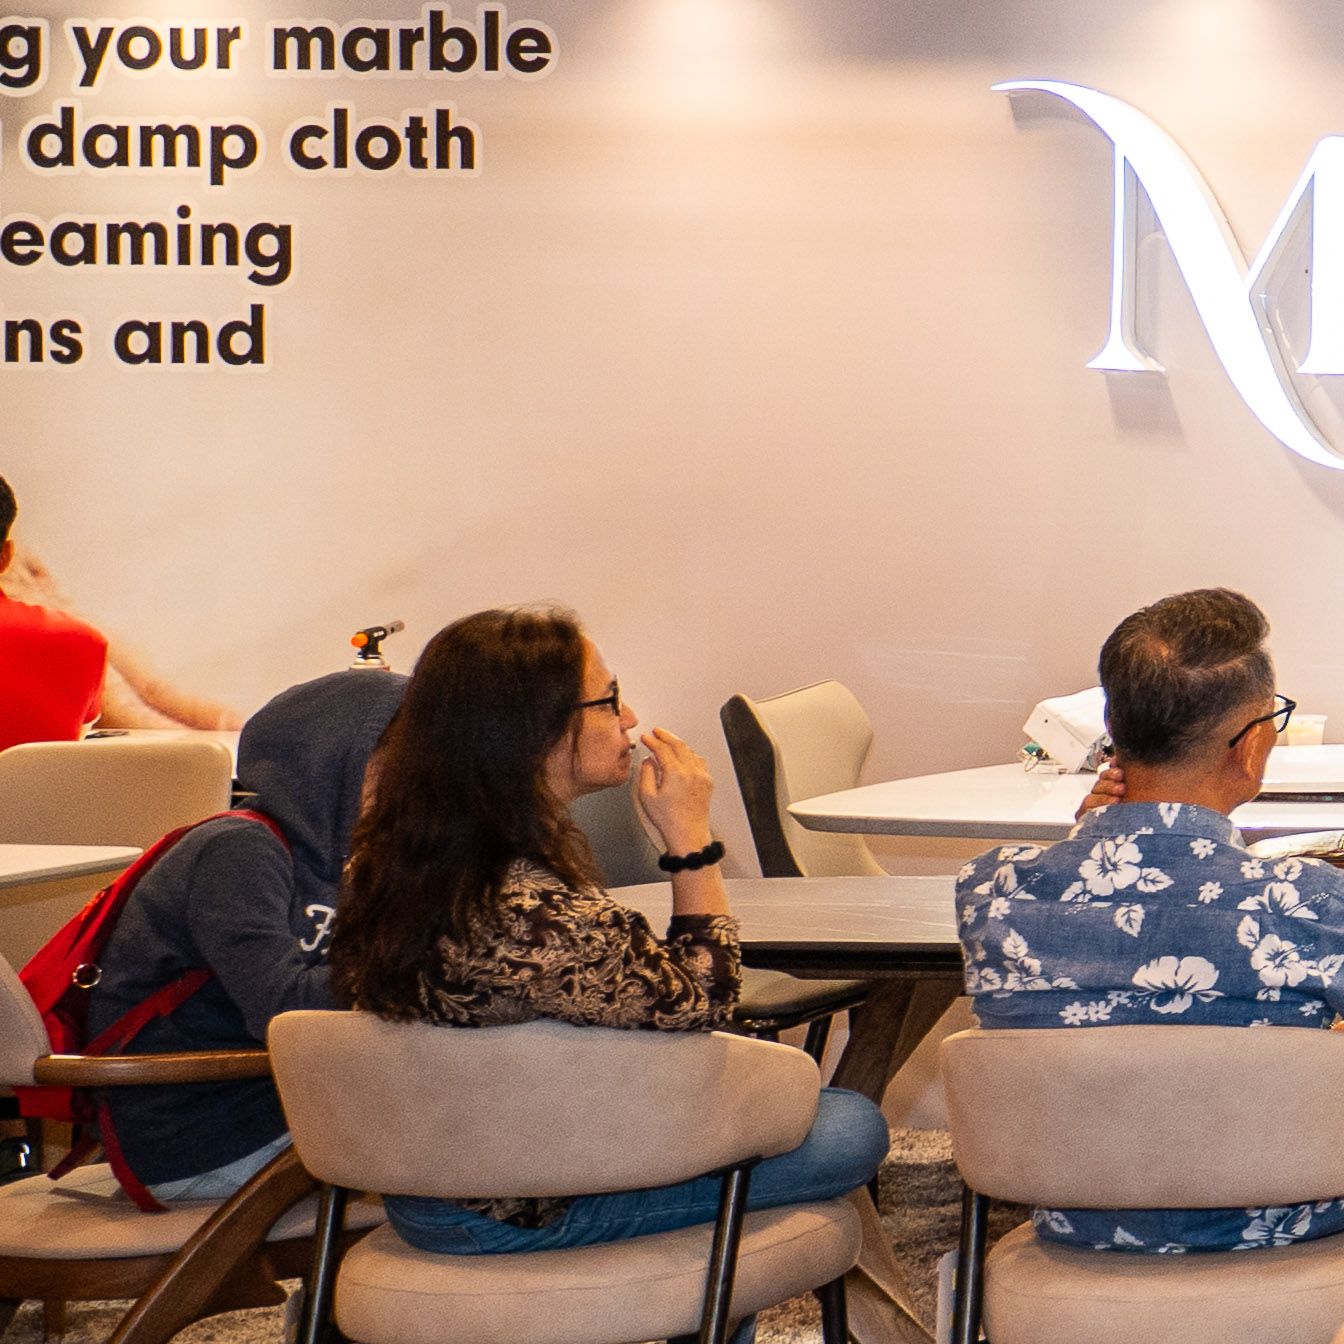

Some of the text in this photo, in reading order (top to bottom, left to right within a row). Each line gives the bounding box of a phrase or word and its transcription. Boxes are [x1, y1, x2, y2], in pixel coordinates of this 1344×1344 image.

[72, 26, 240, 87] your
[273, 9, 552, 74] marble
[26, 106, 475, 186] damp cloth
[0, 204, 292, 287] eaming
[4, 303, 265, 366] ns and
